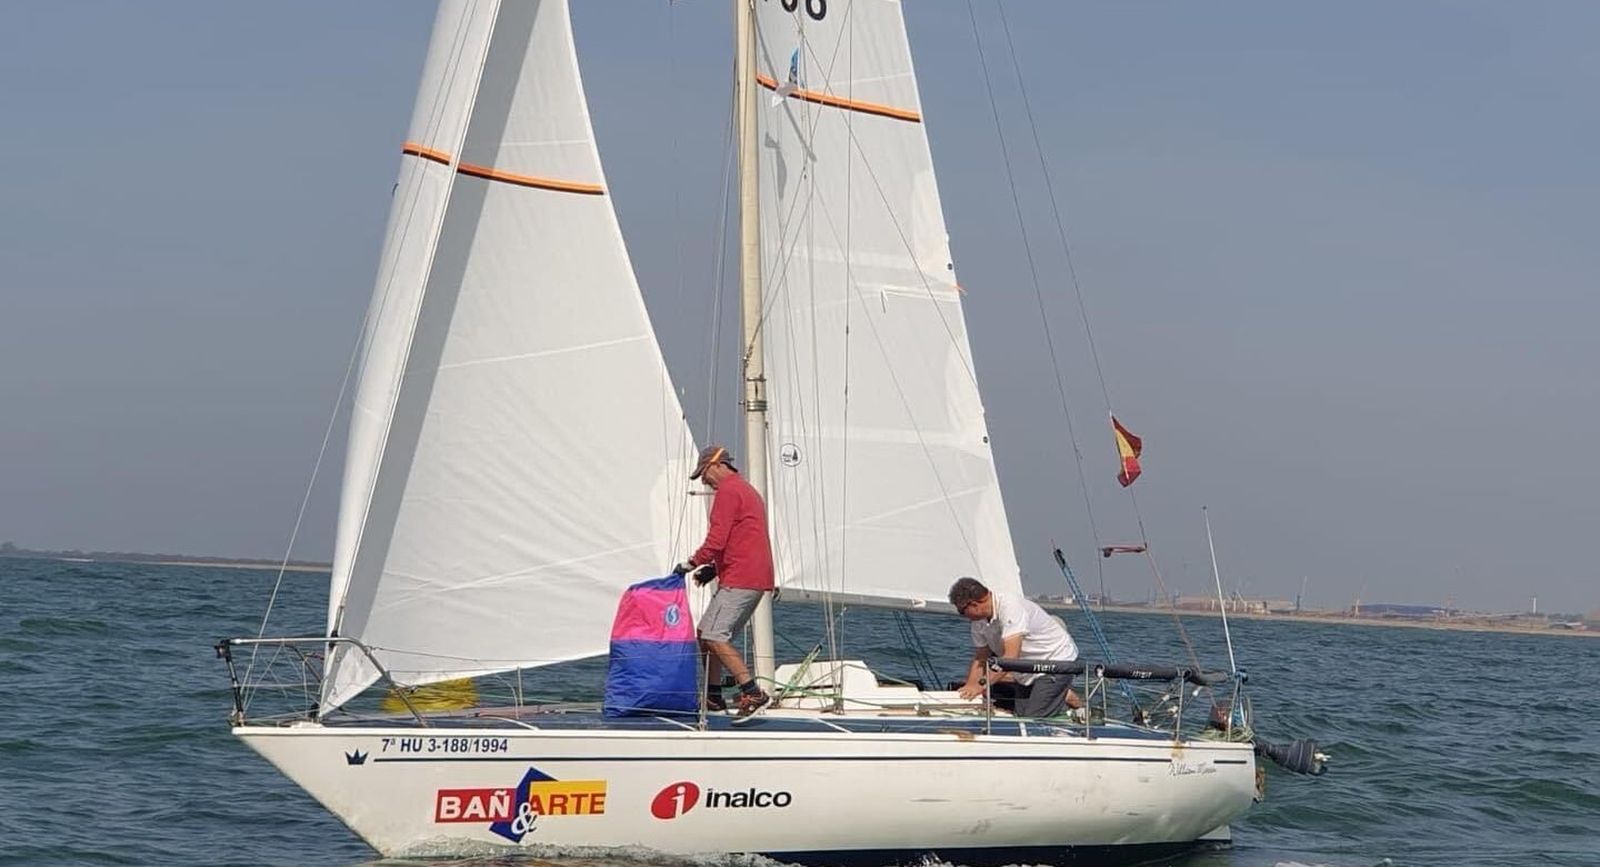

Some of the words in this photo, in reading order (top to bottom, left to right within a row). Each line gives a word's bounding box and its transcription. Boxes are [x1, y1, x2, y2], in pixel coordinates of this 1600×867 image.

[400, 738, 423, 753] HU
[428, 738, 508, 753] 3-188/1994
[439, 789, 511, 819] BAÑ
[530, 793, 606, 816] ARTE
[705, 788, 792, 808] inalco
